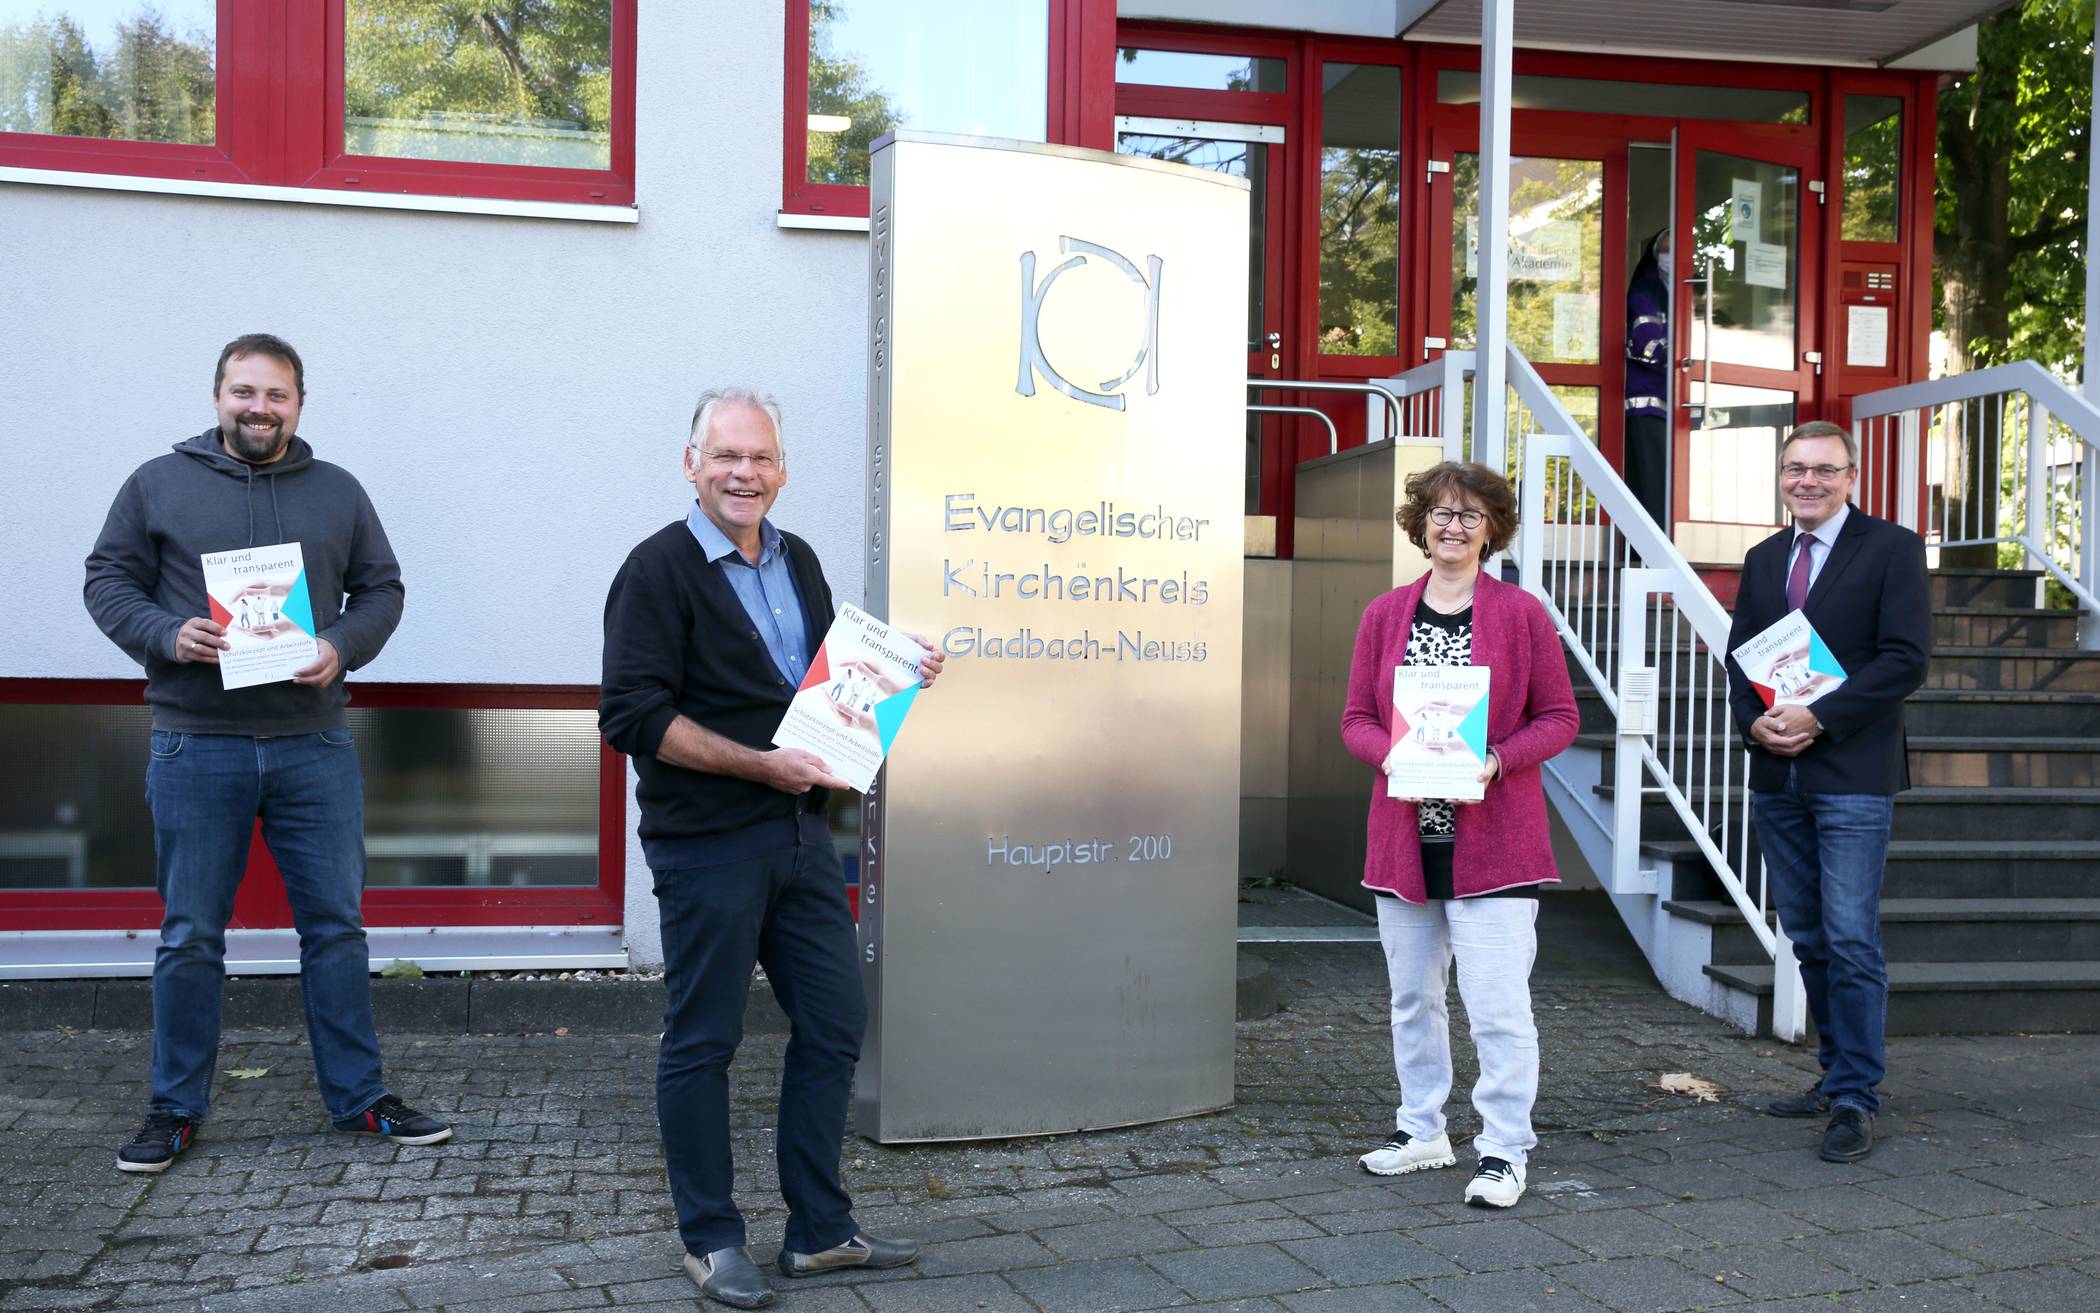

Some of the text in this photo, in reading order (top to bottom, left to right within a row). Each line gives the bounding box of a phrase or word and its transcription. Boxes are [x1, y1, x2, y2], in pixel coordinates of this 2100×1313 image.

[944, 493, 1210, 544] Evangelischer
[206, 552, 252, 566] Klar und
[233, 559, 295, 575] transparent
[943, 558, 1210, 605] Kirchenkreis
[843, 607, 889, 639] Klar und
[861, 634, 919, 674] transparent
[942, 626, 1208, 663] Gladbach-Neuss
[1735, 635, 1768, 659] Klar und
[1758, 625, 1803, 657] transparent
[1398, 669, 1440, 678] Klar und
[1421, 681, 1480, 691] transparent
[987, 834, 1172, 874] Hauptstr. 200
